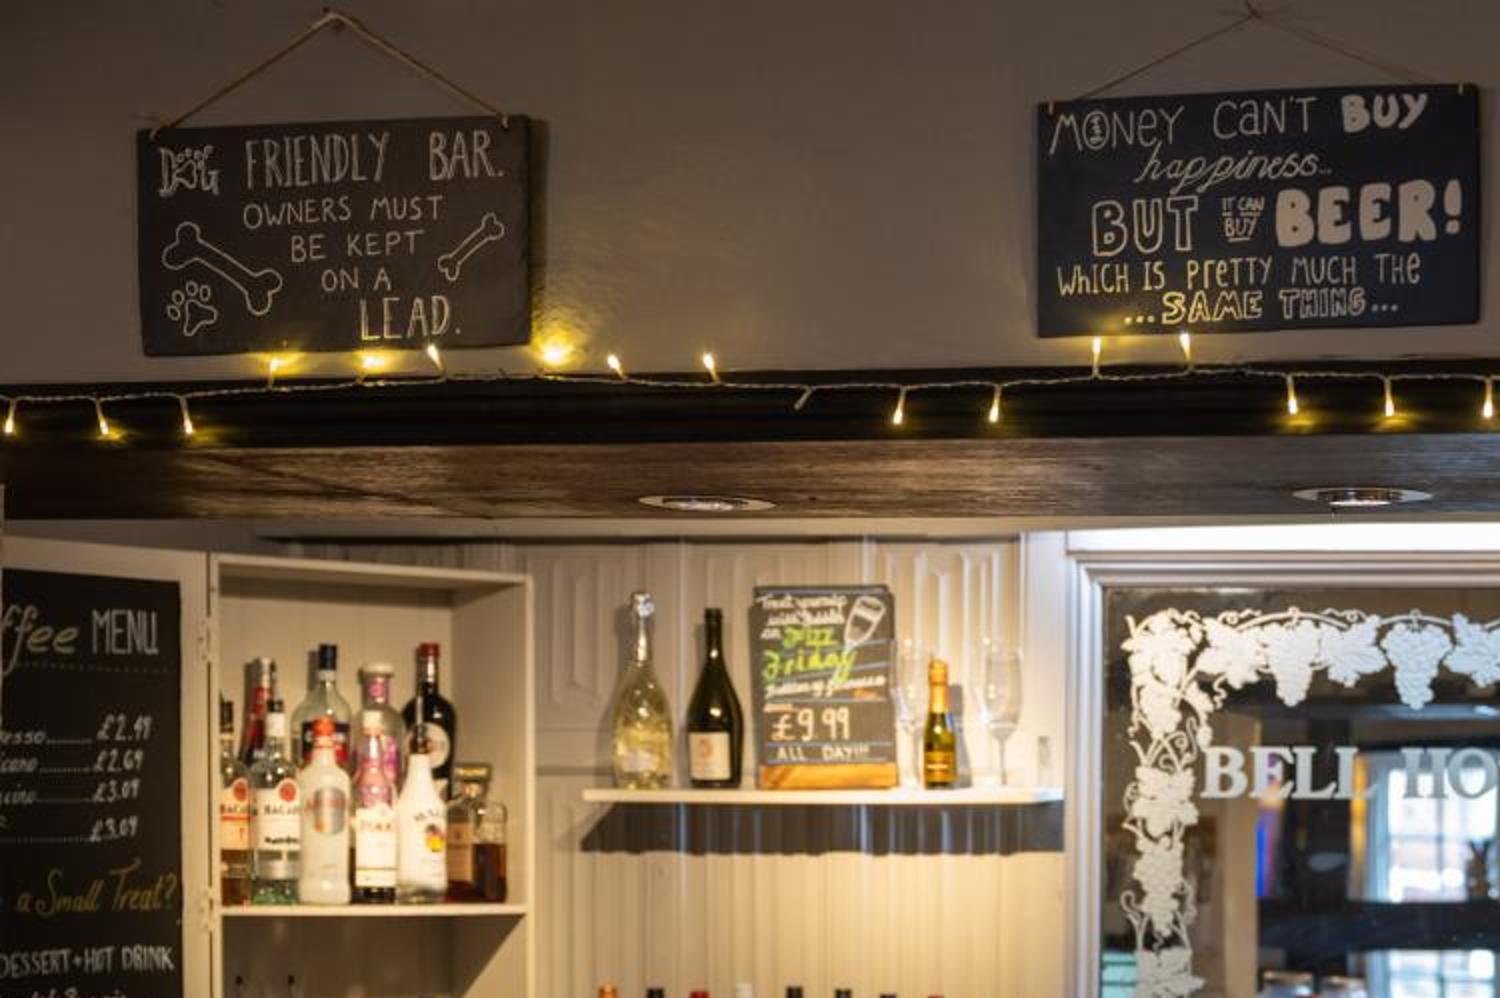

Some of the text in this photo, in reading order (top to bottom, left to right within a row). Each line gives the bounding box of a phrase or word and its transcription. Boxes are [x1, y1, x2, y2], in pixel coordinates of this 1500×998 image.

[1341, 93, 1428, 133] BUY
[245, 132, 390, 188] FRIENDLY
[428, 130, 504, 181] BAR.
[243, 196, 443, 230] OWNERS MUST
[1238, 196, 1265, 212] CAN
[1275, 178, 1462, 248] BEER!
[1092, 195, 1199, 257] BUT
[1225, 216, 1257, 238] BUY
[291, 230, 425, 263] BE KEPT
[321, 268, 392, 292] ON A
[1143, 263, 1165, 292] IS
[1290, 256, 1357, 287] MUCH
[360, 296, 461, 341] LEAD.
[92, 609, 159, 654] MENU
[776, 746, 806, 761] ALL
[1199, 746, 1381, 801] BELL
[36, 868, 104, 916] Small
[84, 946, 115, 974] HOT
[121, 944, 175, 972] DRINK
